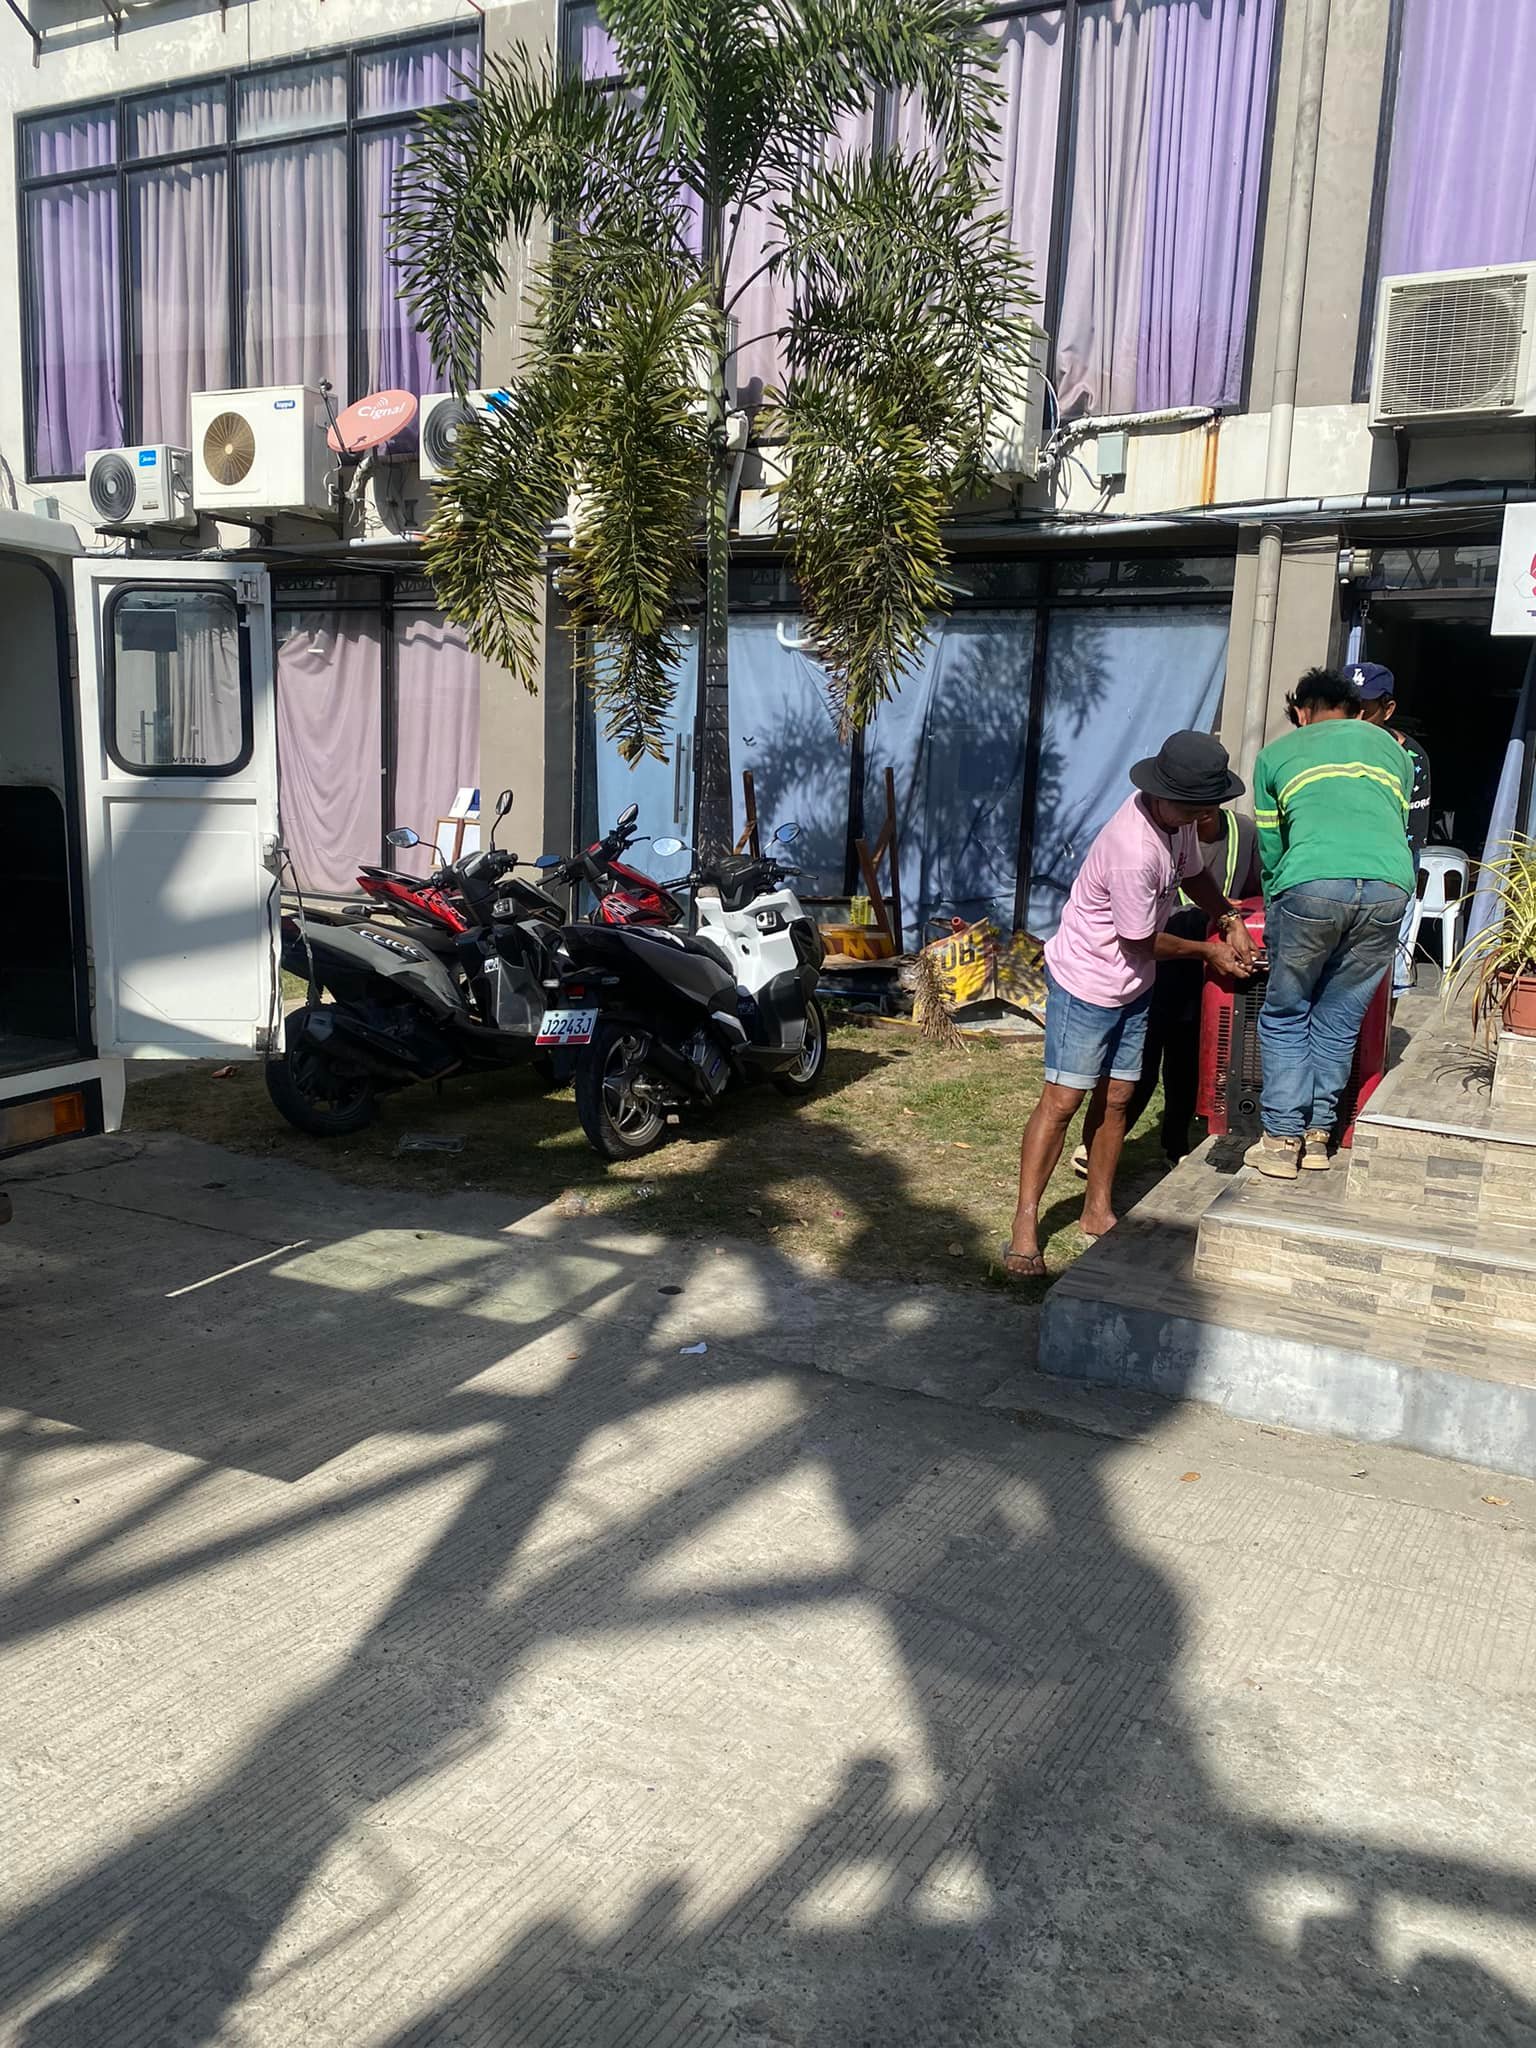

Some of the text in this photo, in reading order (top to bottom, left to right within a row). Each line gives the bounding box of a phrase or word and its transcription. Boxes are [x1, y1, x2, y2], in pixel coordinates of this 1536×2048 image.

[358, 401, 406, 420] Cignal
[1352, 668, 1365, 686] LA
[359, 930, 418, 956] CLICK
